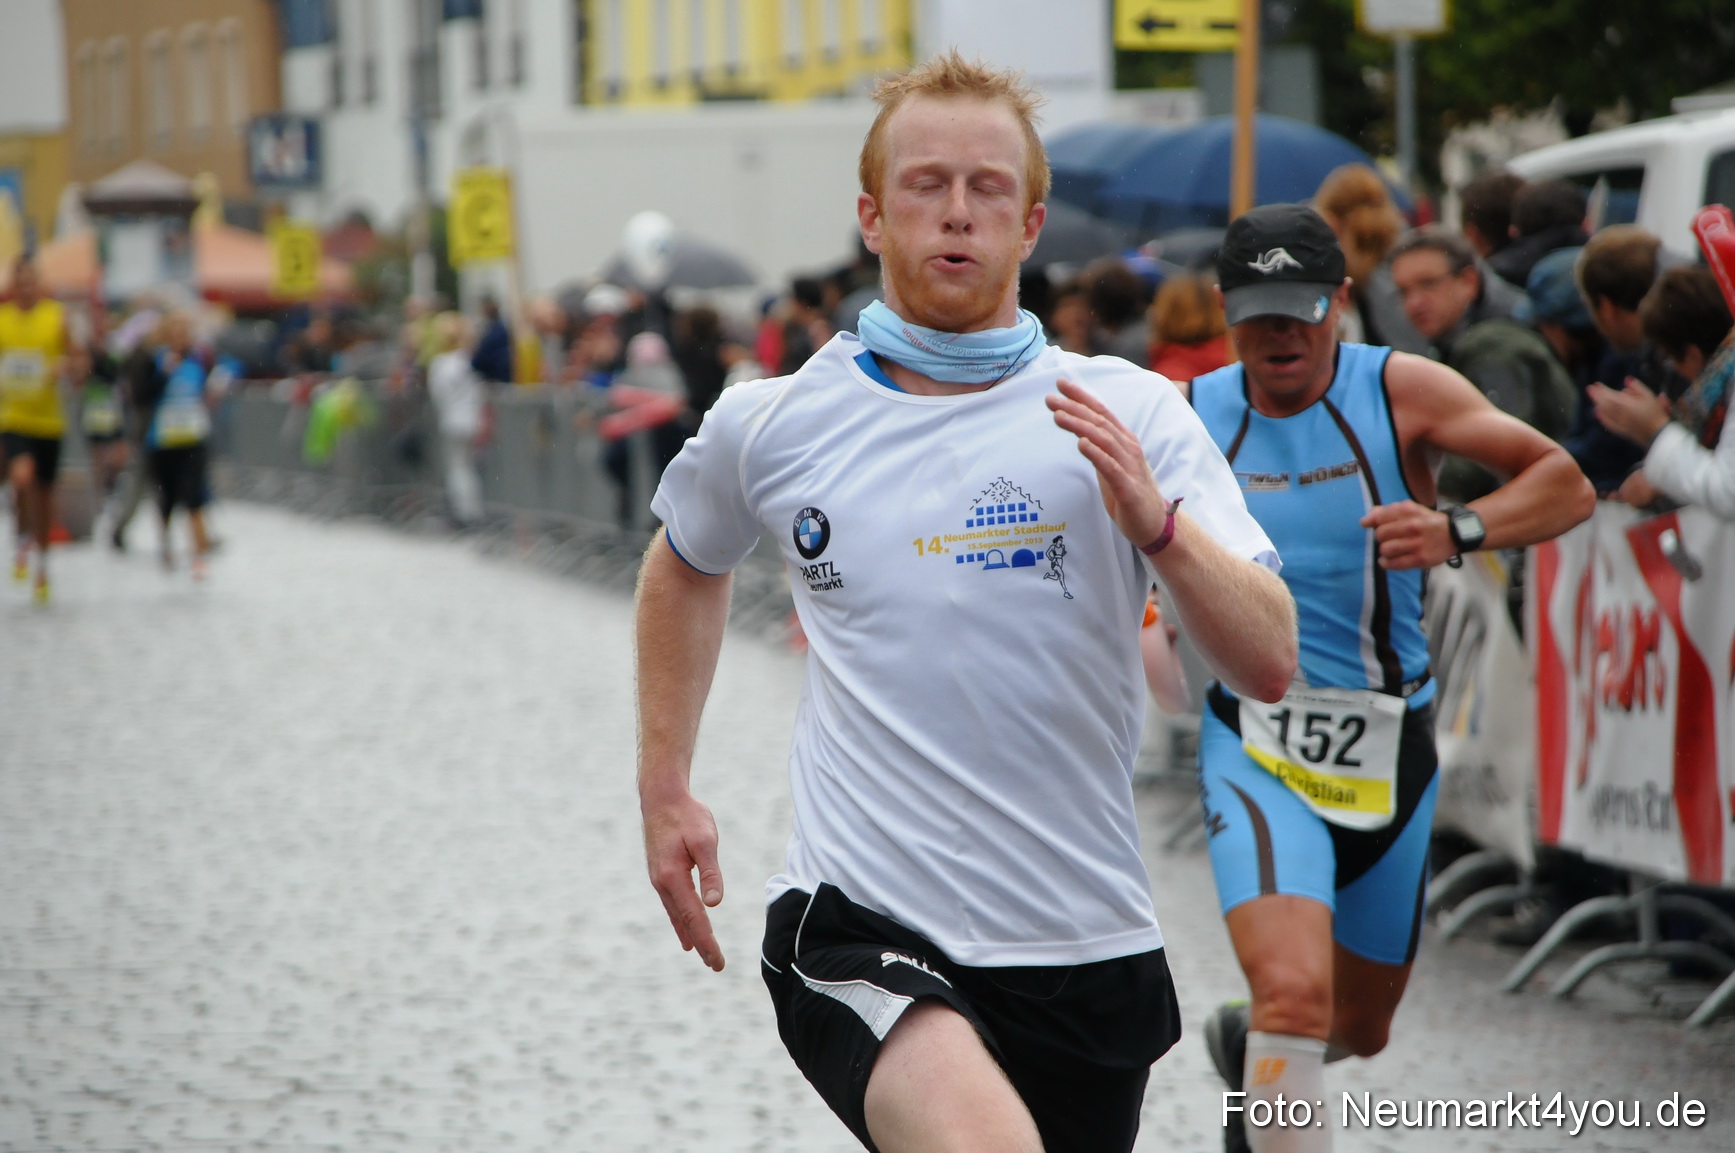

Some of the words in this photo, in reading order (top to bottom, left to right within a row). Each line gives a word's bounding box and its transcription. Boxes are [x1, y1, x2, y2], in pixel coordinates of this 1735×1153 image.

[794, 508, 826, 528] BMW
[912, 535, 950, 557] 14.
[943, 527, 1011, 543] Neumarkter
[1013, 521, 1068, 536] Stadtlauf
[1024, 537, 1044, 546] 2013
[1268, 707, 1368, 768] 152
